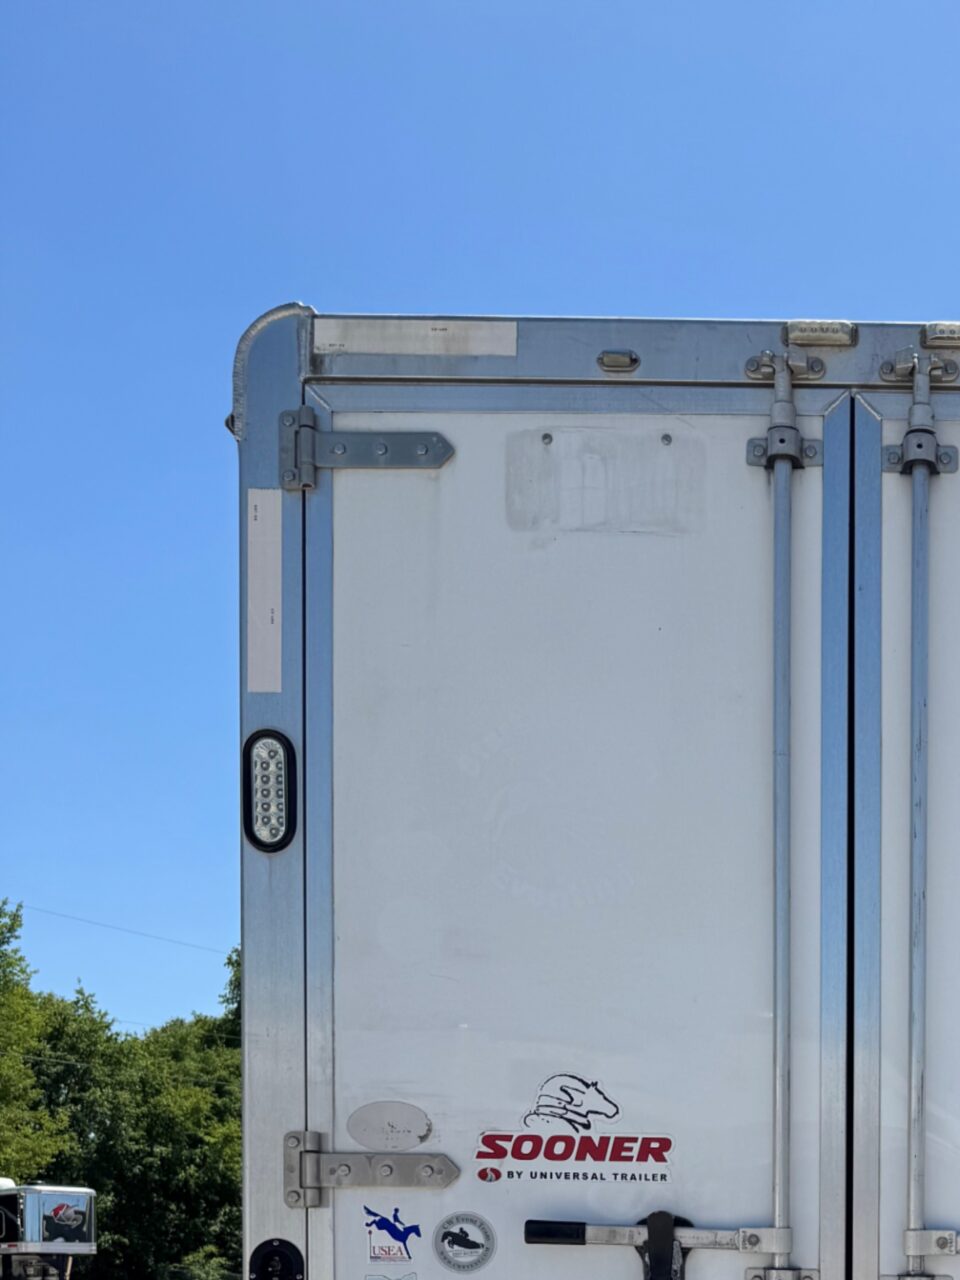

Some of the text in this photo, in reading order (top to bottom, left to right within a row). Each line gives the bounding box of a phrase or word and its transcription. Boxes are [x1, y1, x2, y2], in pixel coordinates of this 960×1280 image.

[475, 1134, 672, 1163] SOONER
[507, 1171, 668, 1182] BY UNIVERSAL TRAILER
[372, 1245, 404, 1256] USEA
